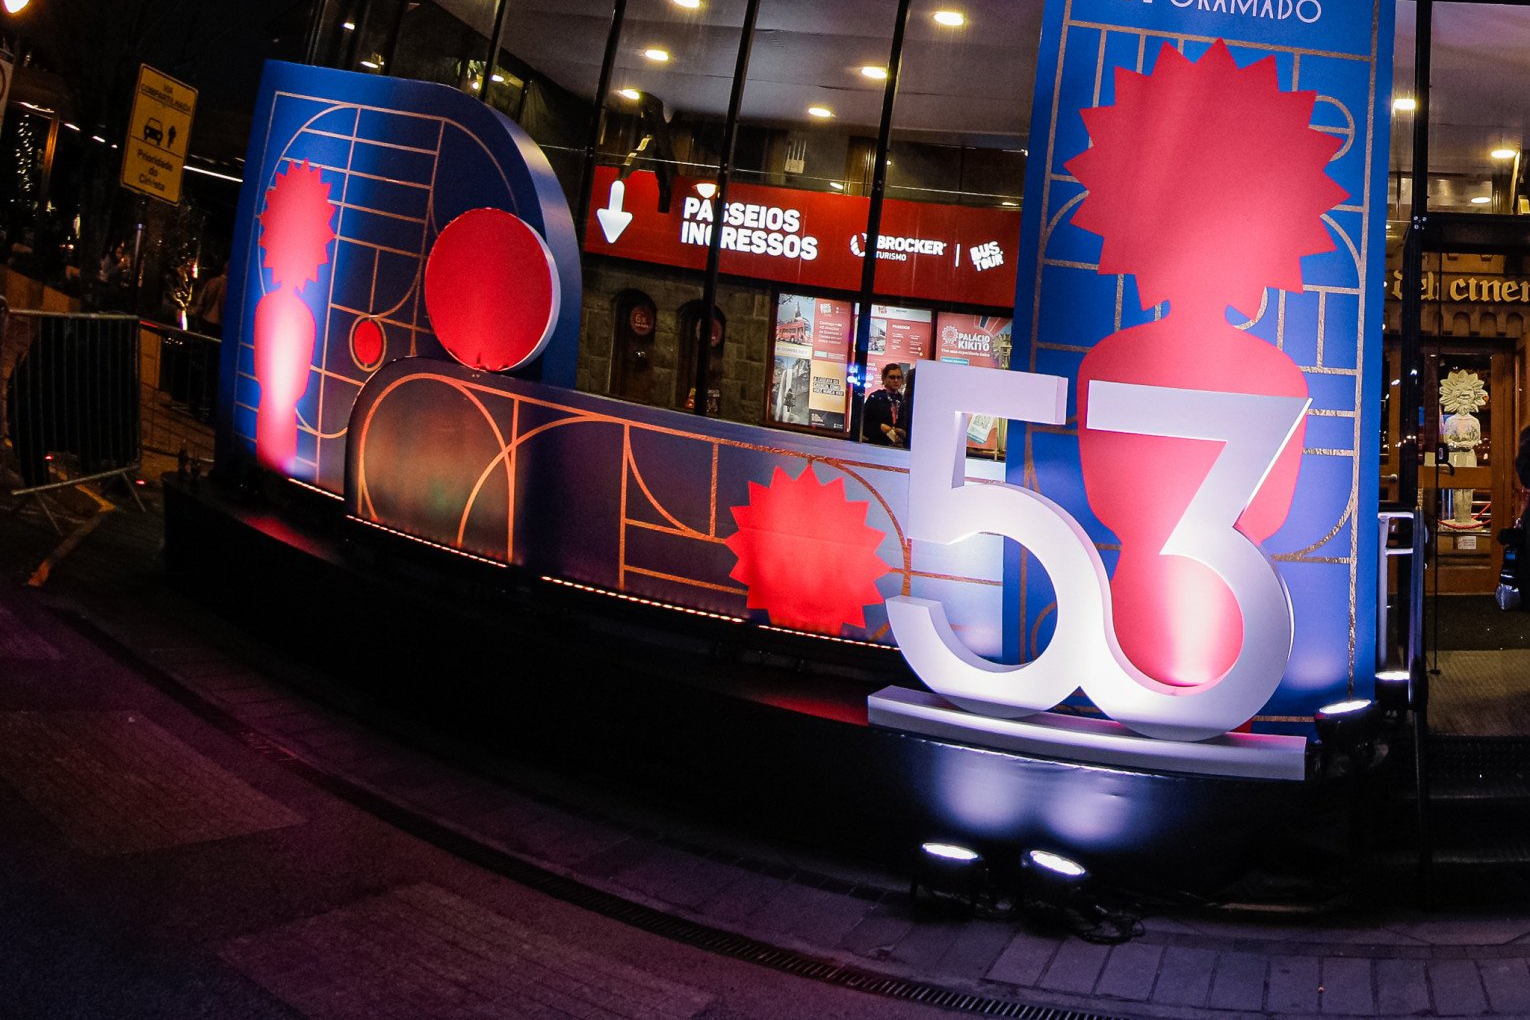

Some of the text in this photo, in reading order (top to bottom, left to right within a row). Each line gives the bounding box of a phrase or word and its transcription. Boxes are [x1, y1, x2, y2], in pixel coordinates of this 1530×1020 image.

[876, 234, 945, 256] BROCKER
[875, 251, 907, 261] TURISMO
[958, 332, 991, 343] PALÁCIO
[958, 340, 990, 352] KIKITO
[886, 358, 1313, 742] 53
